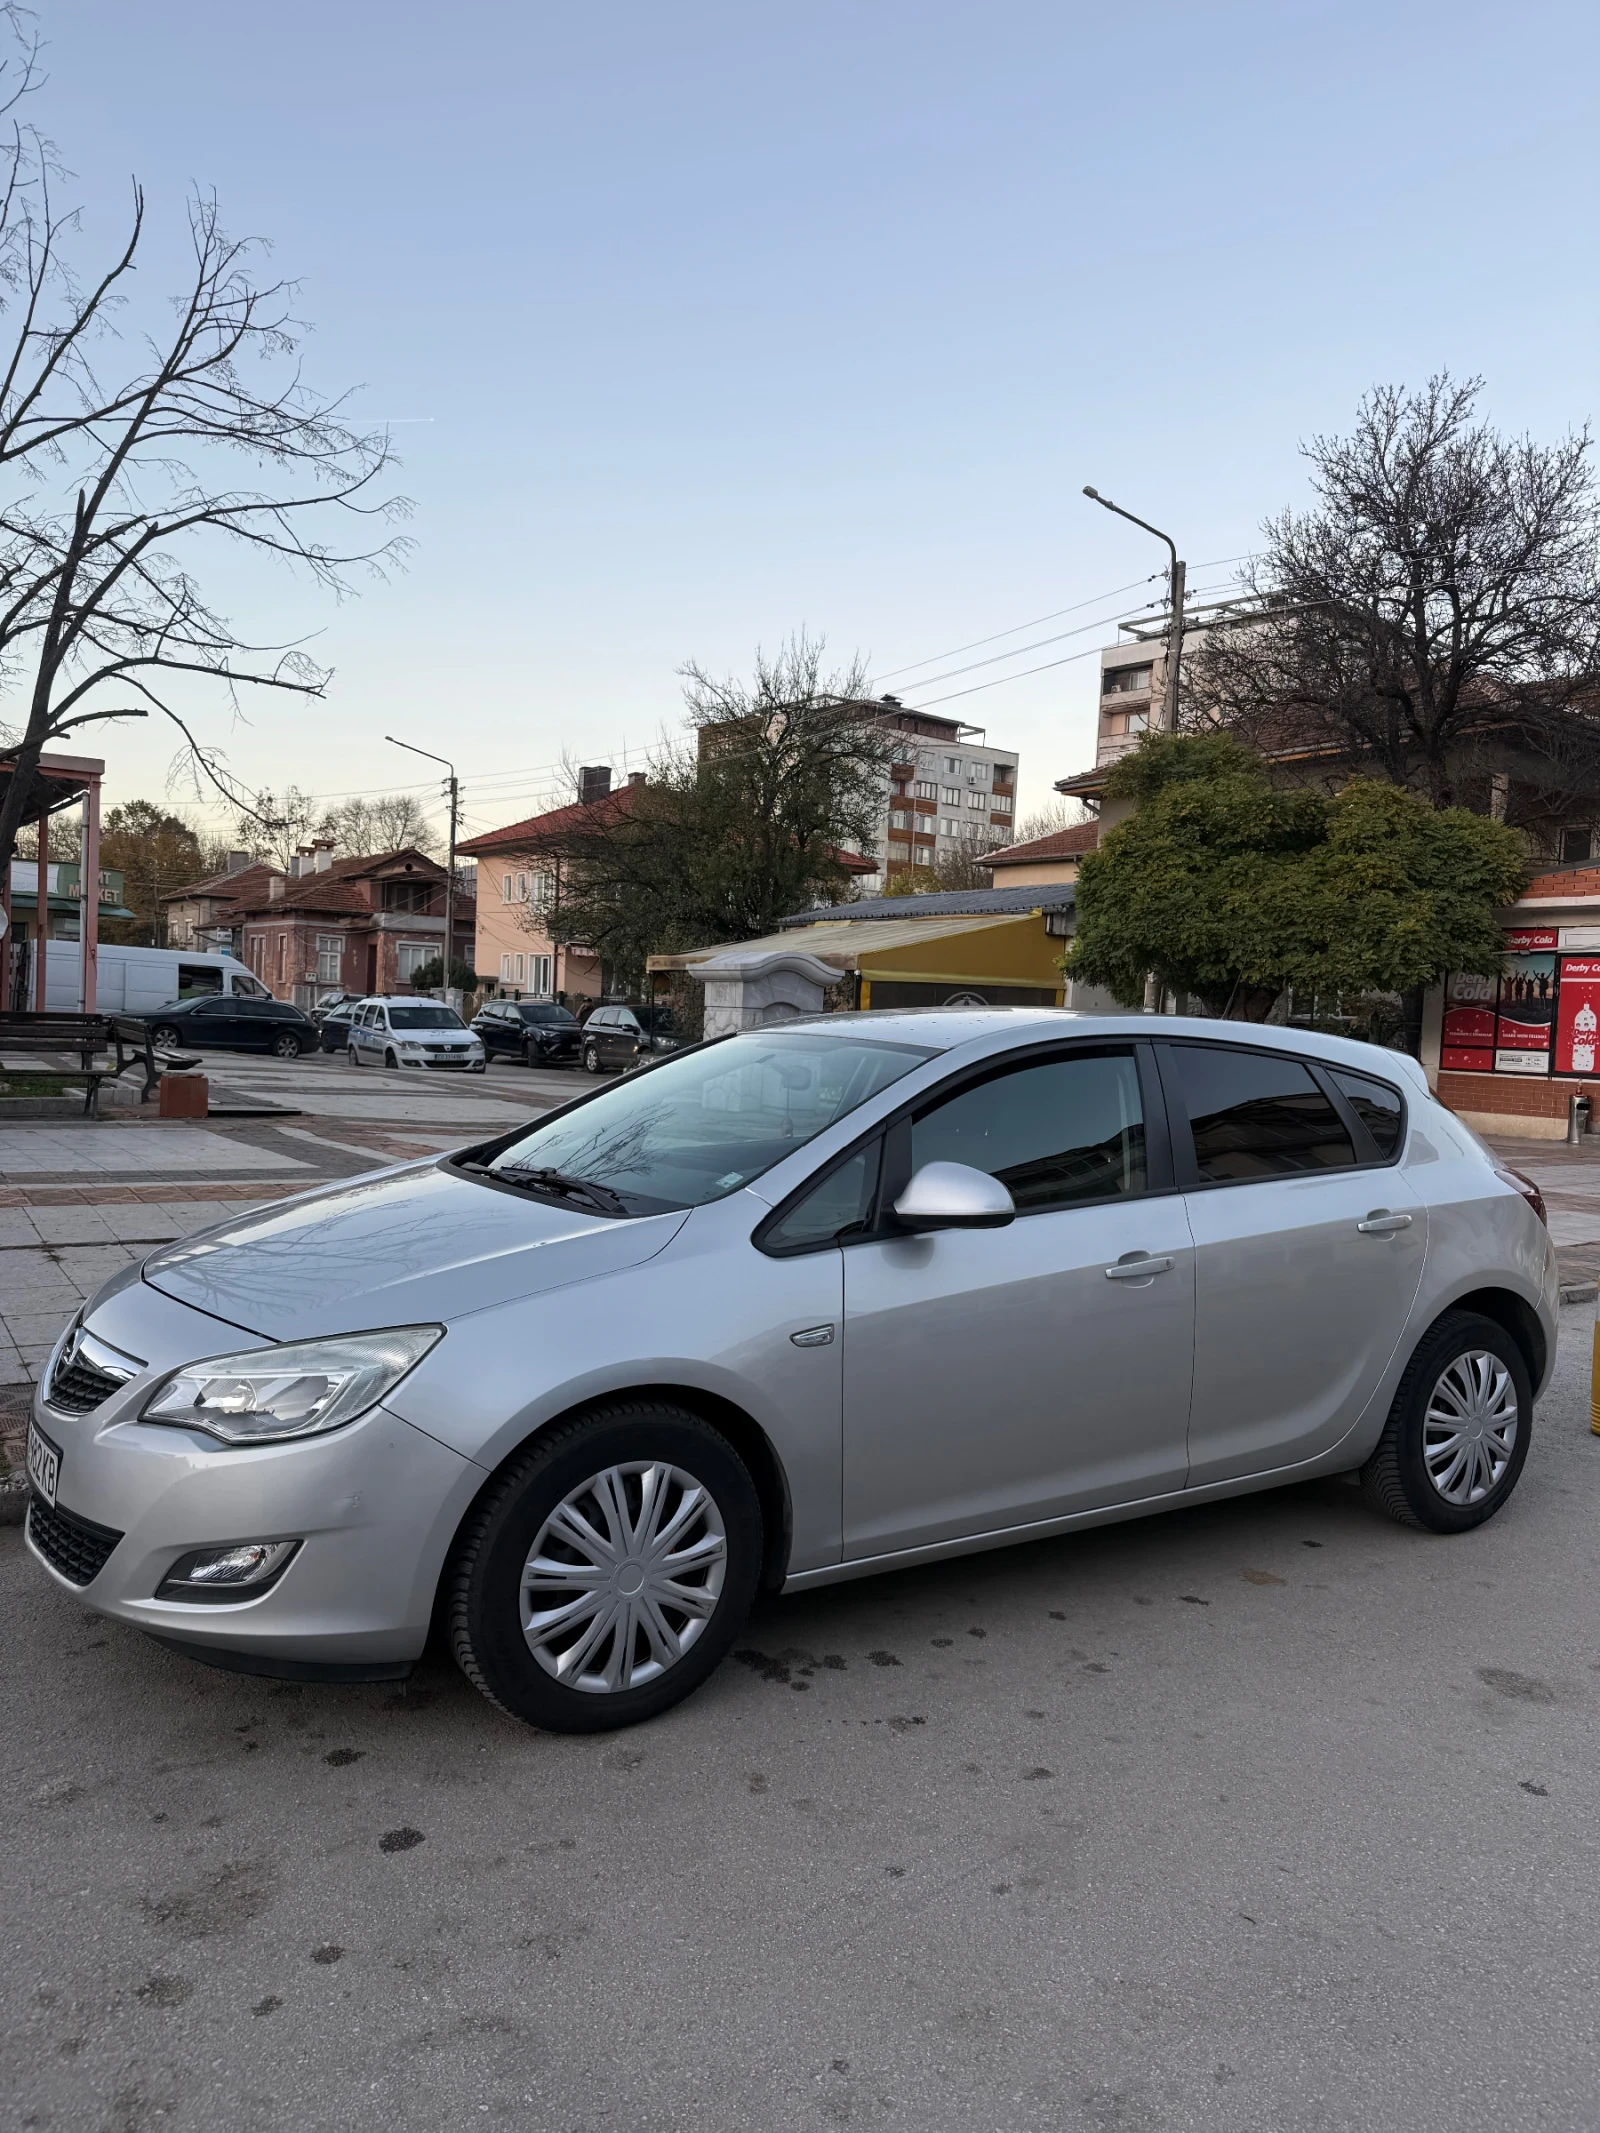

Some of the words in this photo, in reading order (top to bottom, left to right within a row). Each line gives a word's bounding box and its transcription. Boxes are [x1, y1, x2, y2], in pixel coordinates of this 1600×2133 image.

[68, 883, 119, 903] MKET
[1534, 935, 1553, 944] Cola
[1565, 963, 1590, 974] Derby
[1453, 984, 1492, 1000] Cola
[1572, 1036, 1595, 1046] Cola
